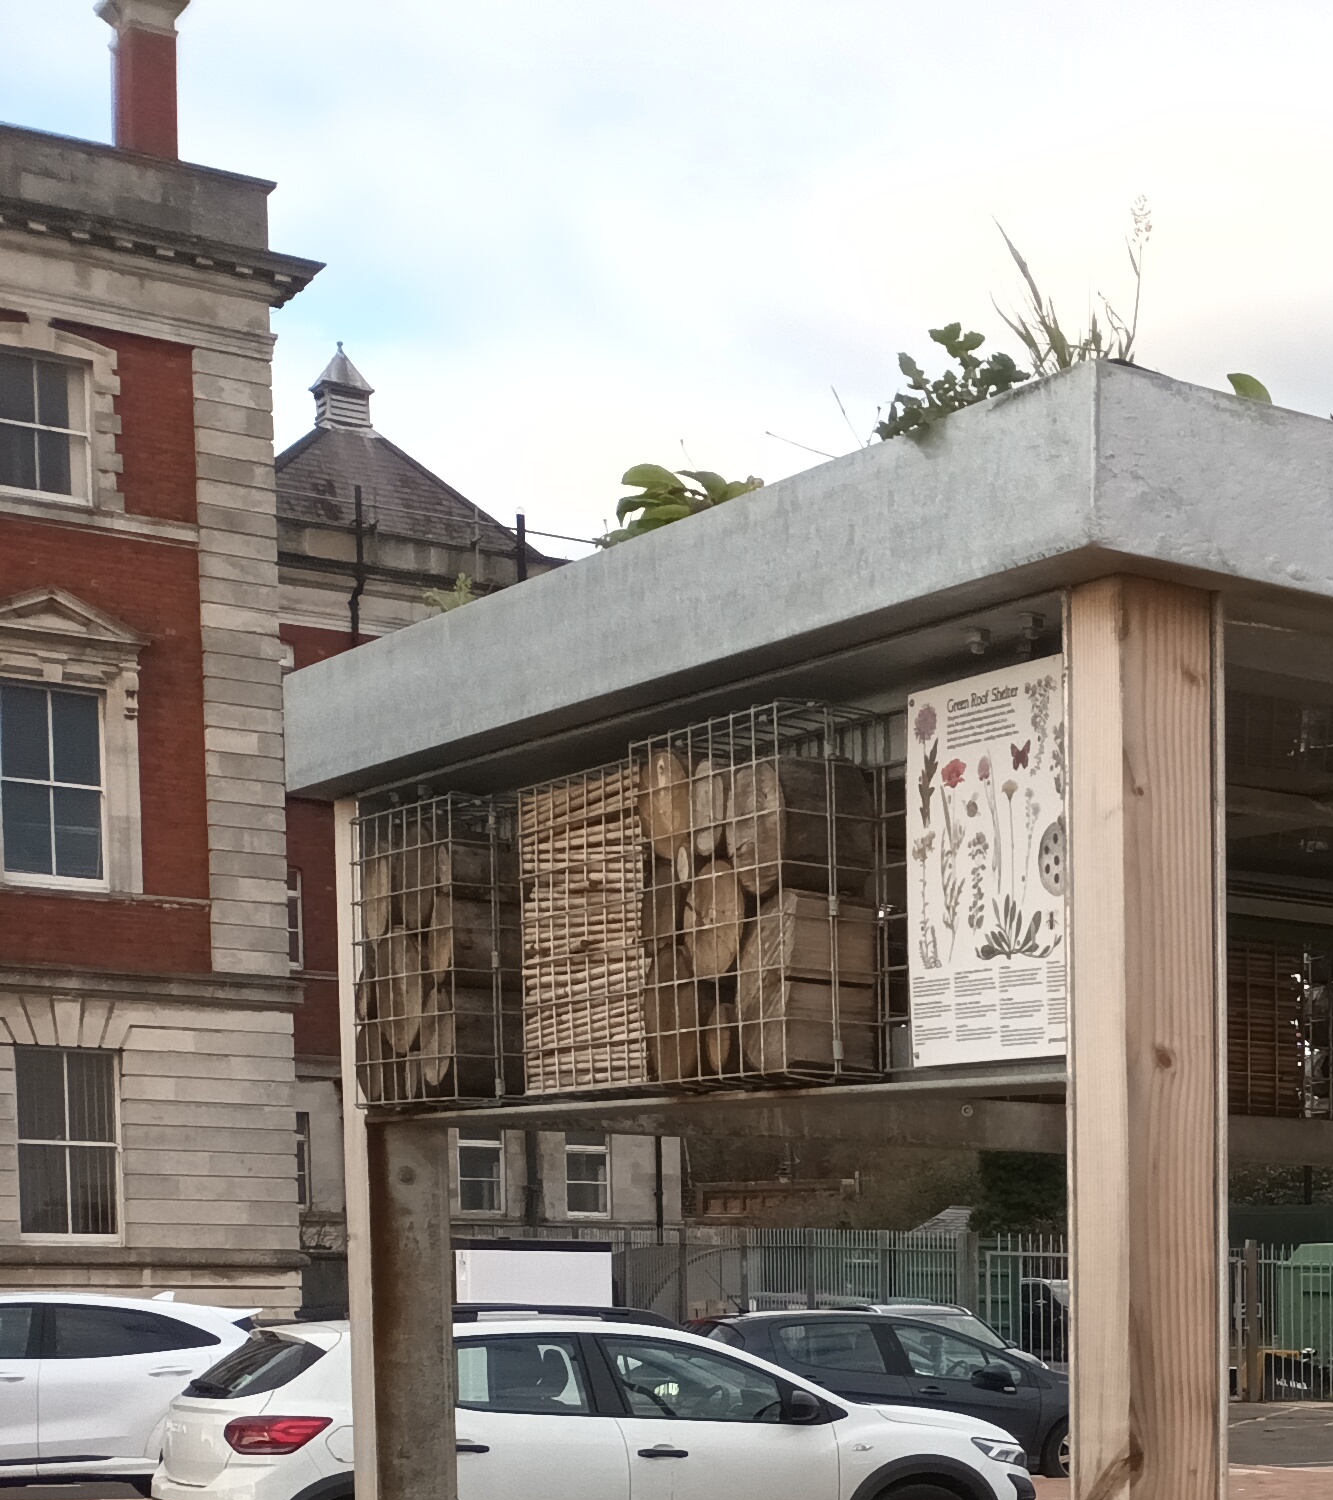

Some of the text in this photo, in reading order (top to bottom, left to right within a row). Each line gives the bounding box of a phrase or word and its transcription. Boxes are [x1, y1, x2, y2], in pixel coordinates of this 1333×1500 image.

[947, 685, 1019, 713] Green Roof Shelter
